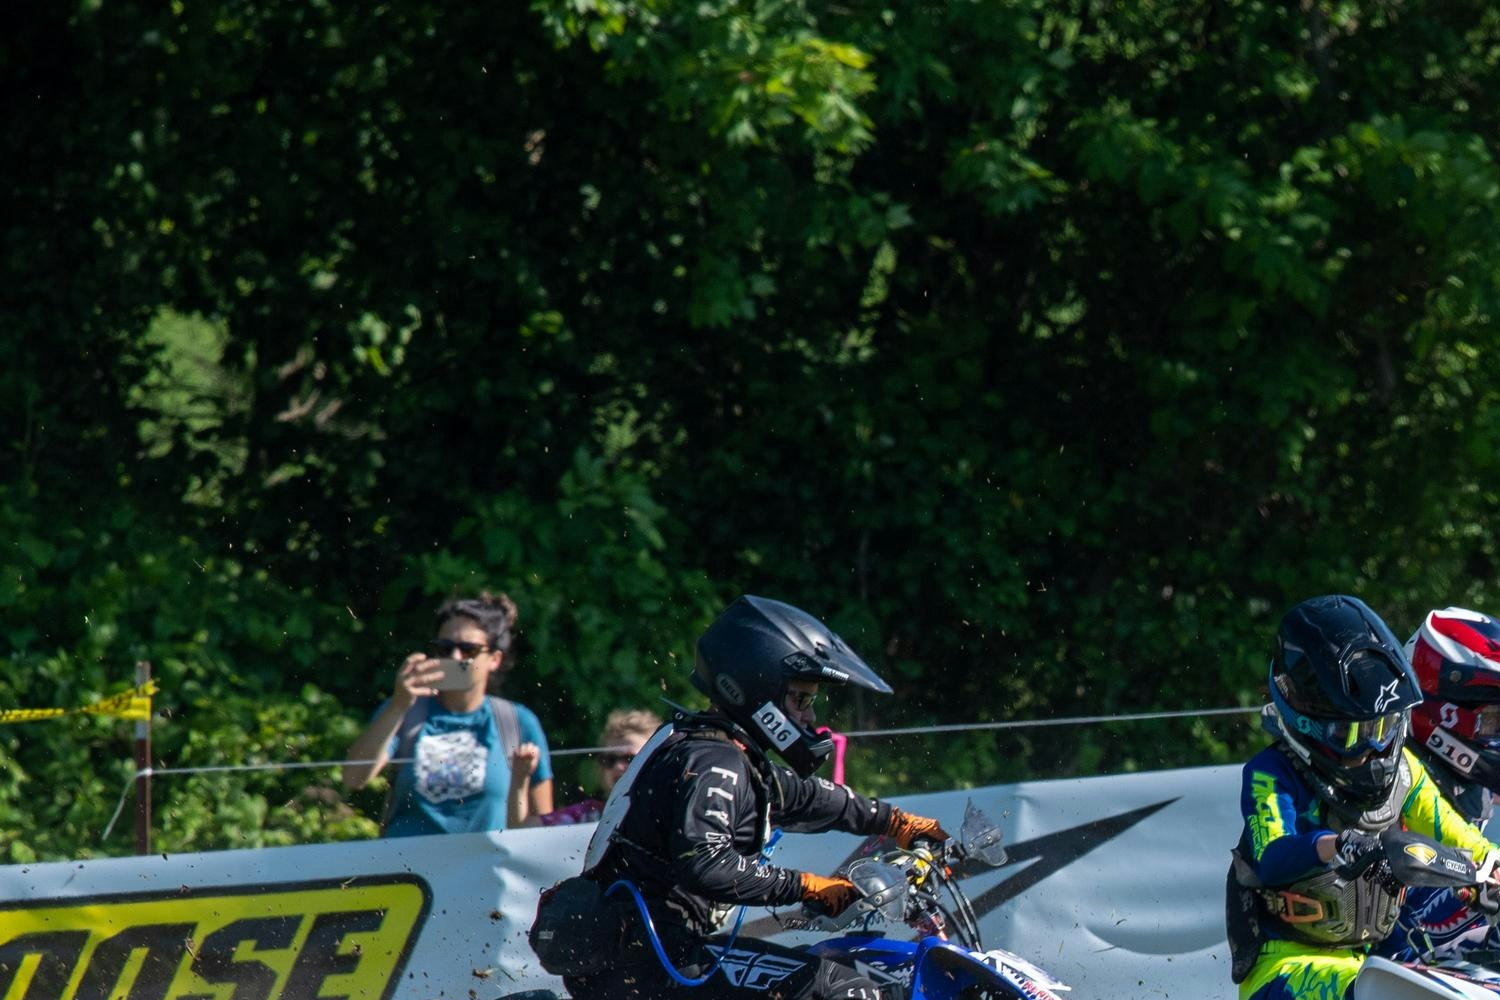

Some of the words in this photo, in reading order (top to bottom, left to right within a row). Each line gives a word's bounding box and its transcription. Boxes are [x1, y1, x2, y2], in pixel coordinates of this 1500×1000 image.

[760, 712, 792, 742] 016
[1428, 733, 1473, 769] 910
[705, 766, 739, 827] FLY
[1445, 860, 1468, 874] CYCRA
